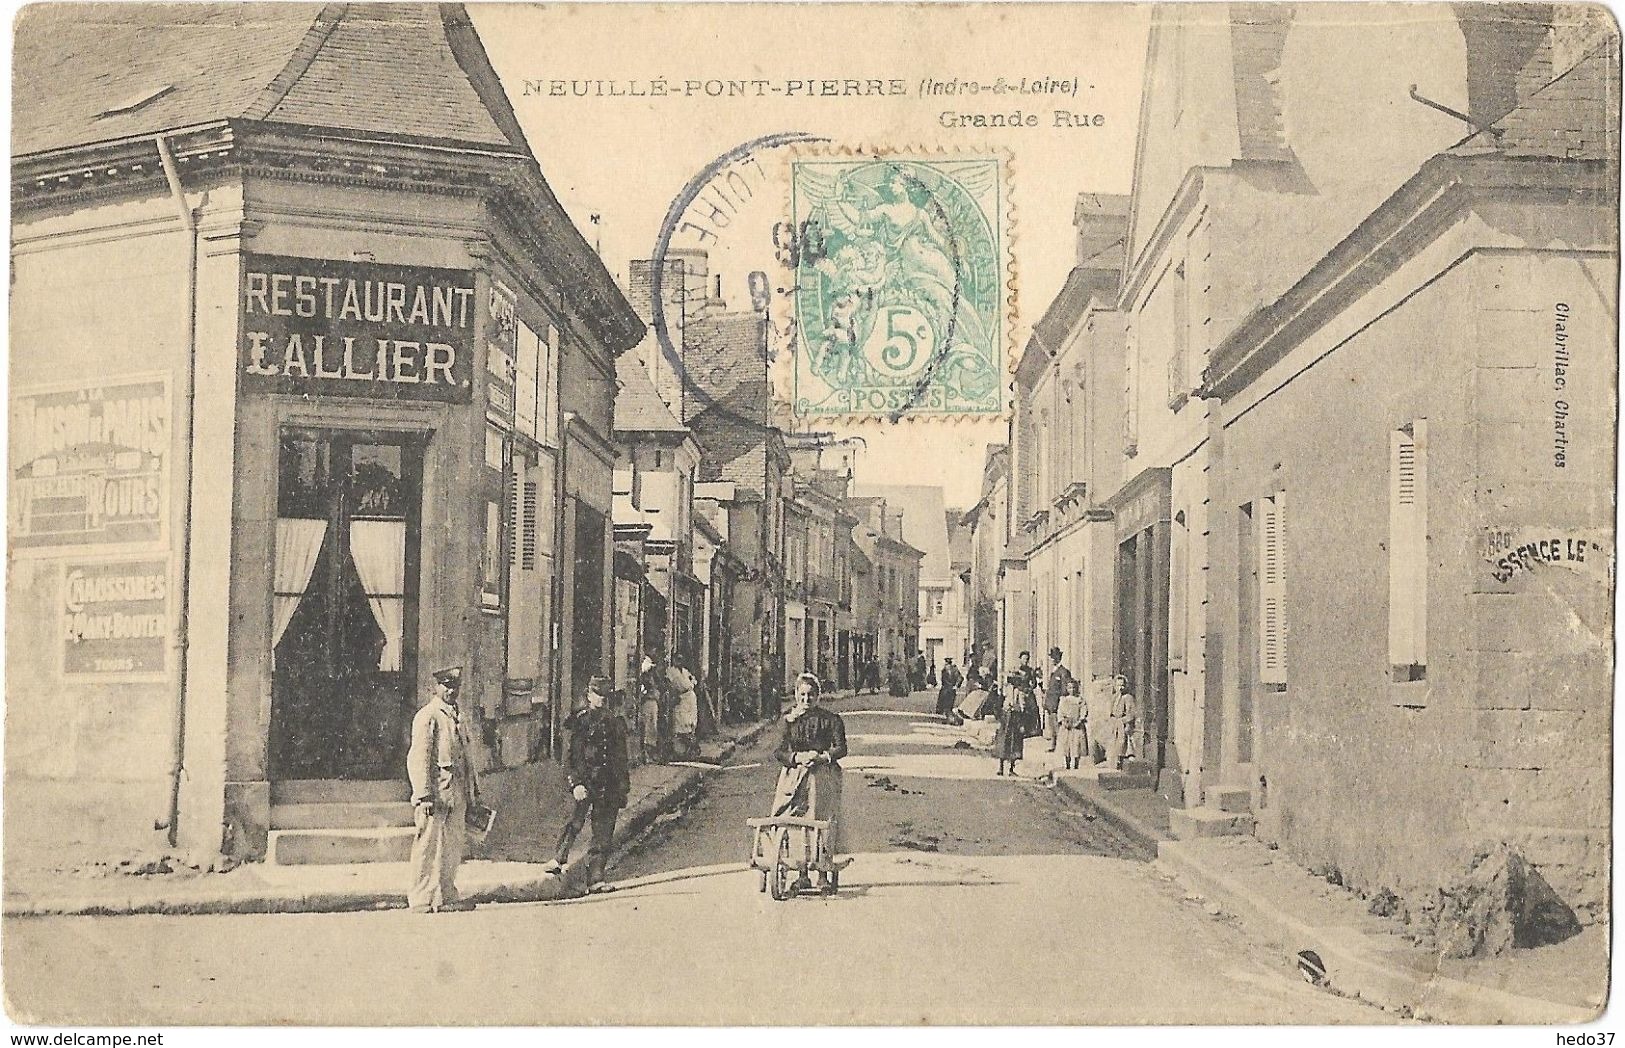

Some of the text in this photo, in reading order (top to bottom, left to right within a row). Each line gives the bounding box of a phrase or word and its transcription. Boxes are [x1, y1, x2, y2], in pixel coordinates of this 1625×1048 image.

[244, 271, 475, 329] RESTAURANT
[1491, 538, 1587, 584] ESSENCE LE
